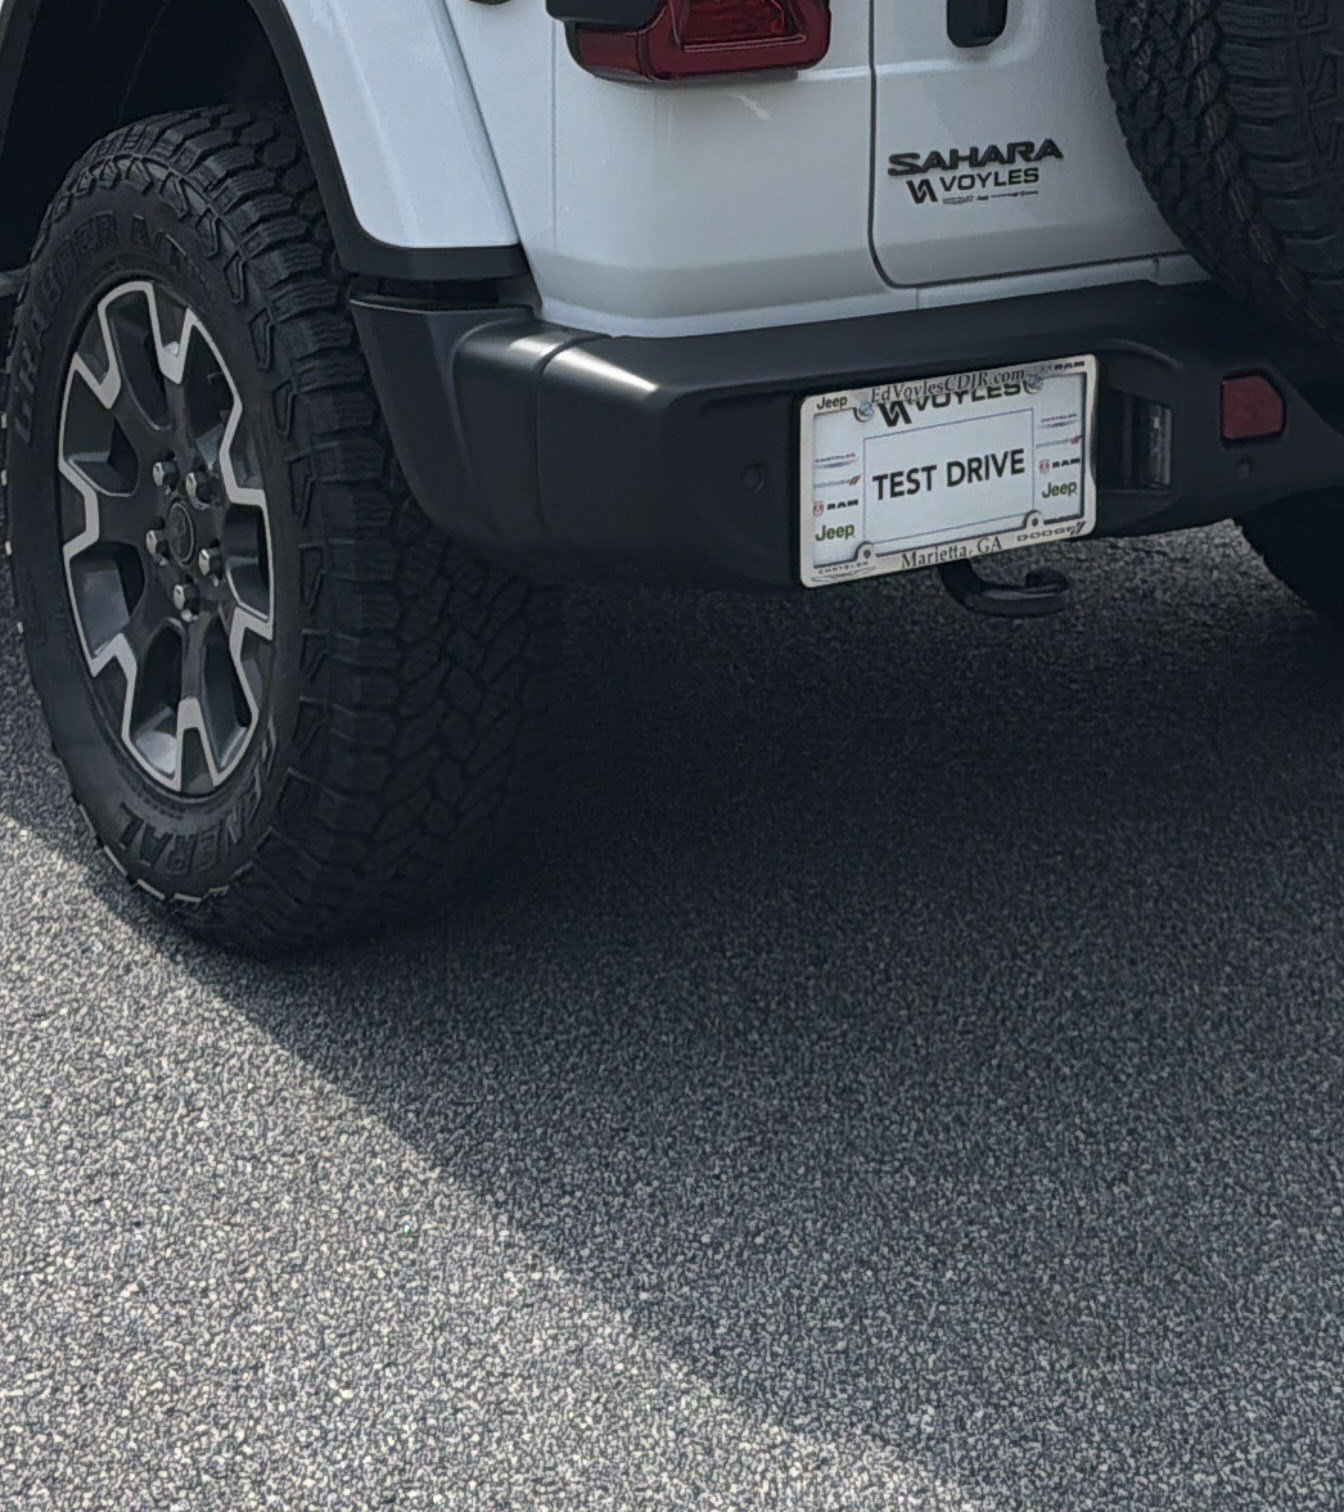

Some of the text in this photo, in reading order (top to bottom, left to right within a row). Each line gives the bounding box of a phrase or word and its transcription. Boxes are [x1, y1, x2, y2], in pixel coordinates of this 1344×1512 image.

[888, 138, 1064, 176] SAHARA
[939, 167, 1039, 191] VOYLES
[816, 396, 848, 410] Jeep
[872, 449, 1026, 500] TEST DRIVE
[1041, 481, 1078, 499] Jeep
[815, 524, 855, 542] Jeep
[976, 536, 1003, 555] GA
